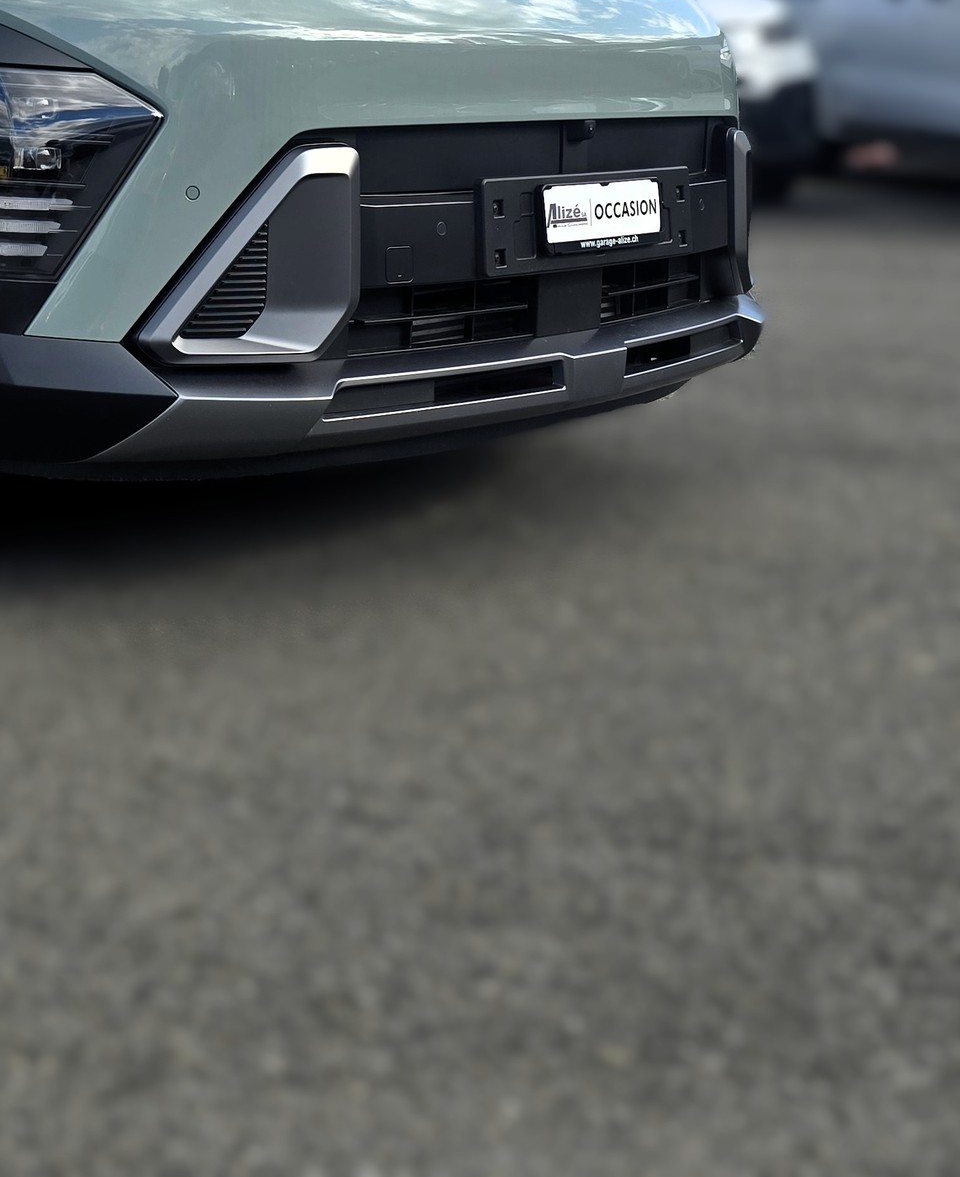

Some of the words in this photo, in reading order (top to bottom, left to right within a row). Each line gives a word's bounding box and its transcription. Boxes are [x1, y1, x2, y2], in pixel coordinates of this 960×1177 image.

[546, 203, 581, 228] Alizé
[594, 199, 657, 220] OCCASION
[580, 235, 639, 248] www.garage-alize.ch
